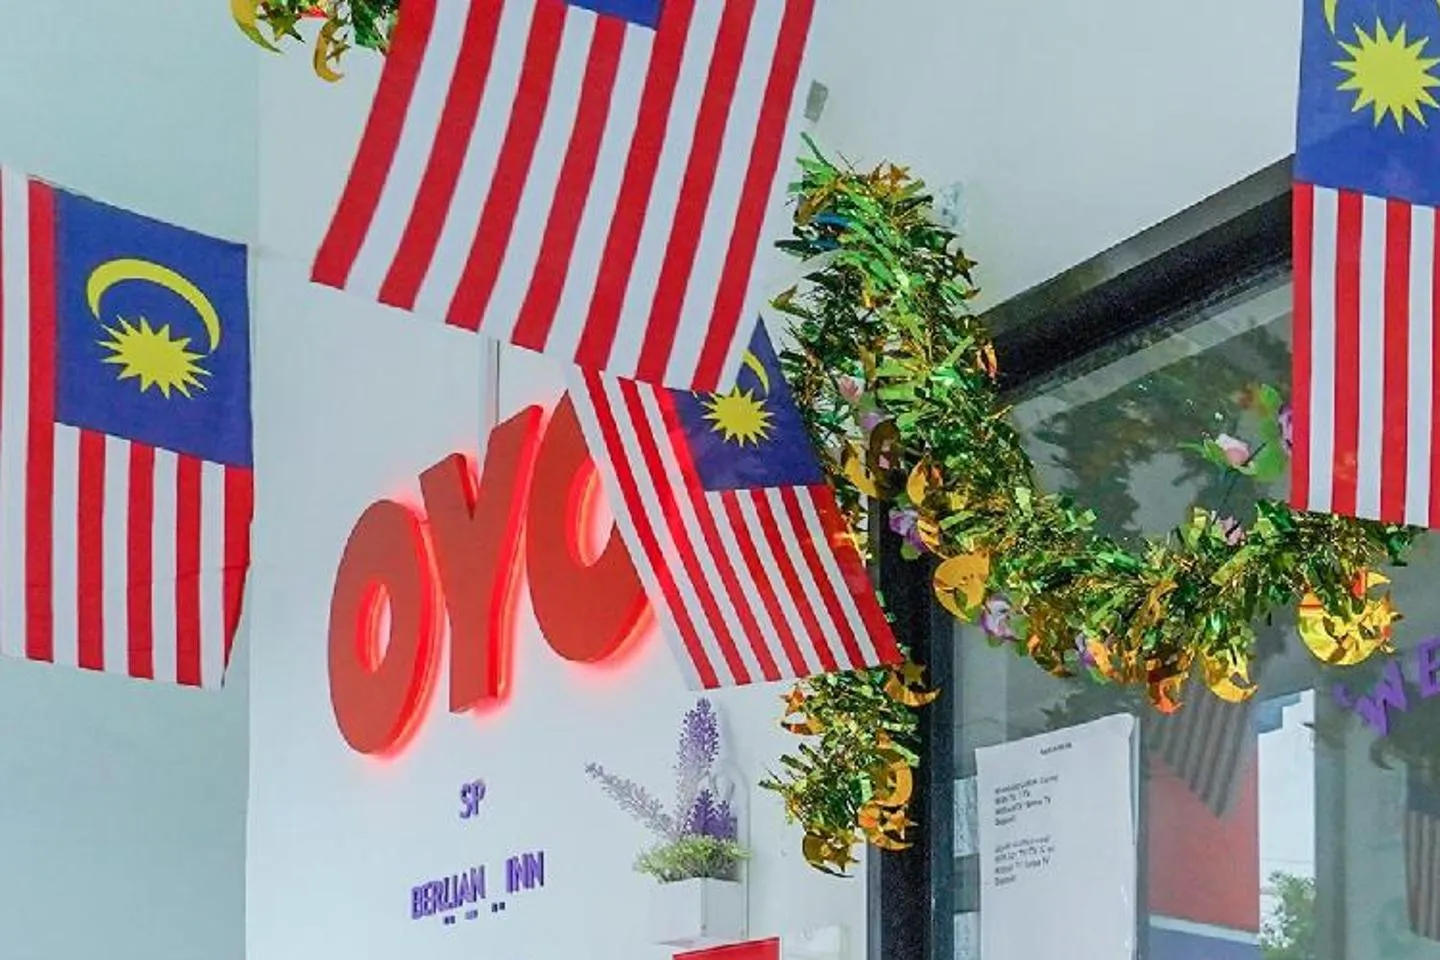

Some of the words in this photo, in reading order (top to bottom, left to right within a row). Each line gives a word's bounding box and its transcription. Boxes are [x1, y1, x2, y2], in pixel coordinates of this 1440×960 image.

[459, 779, 486, 820] SP
[411, 865, 485, 919] BERLIAN
[505, 850, 544, 895] INN
